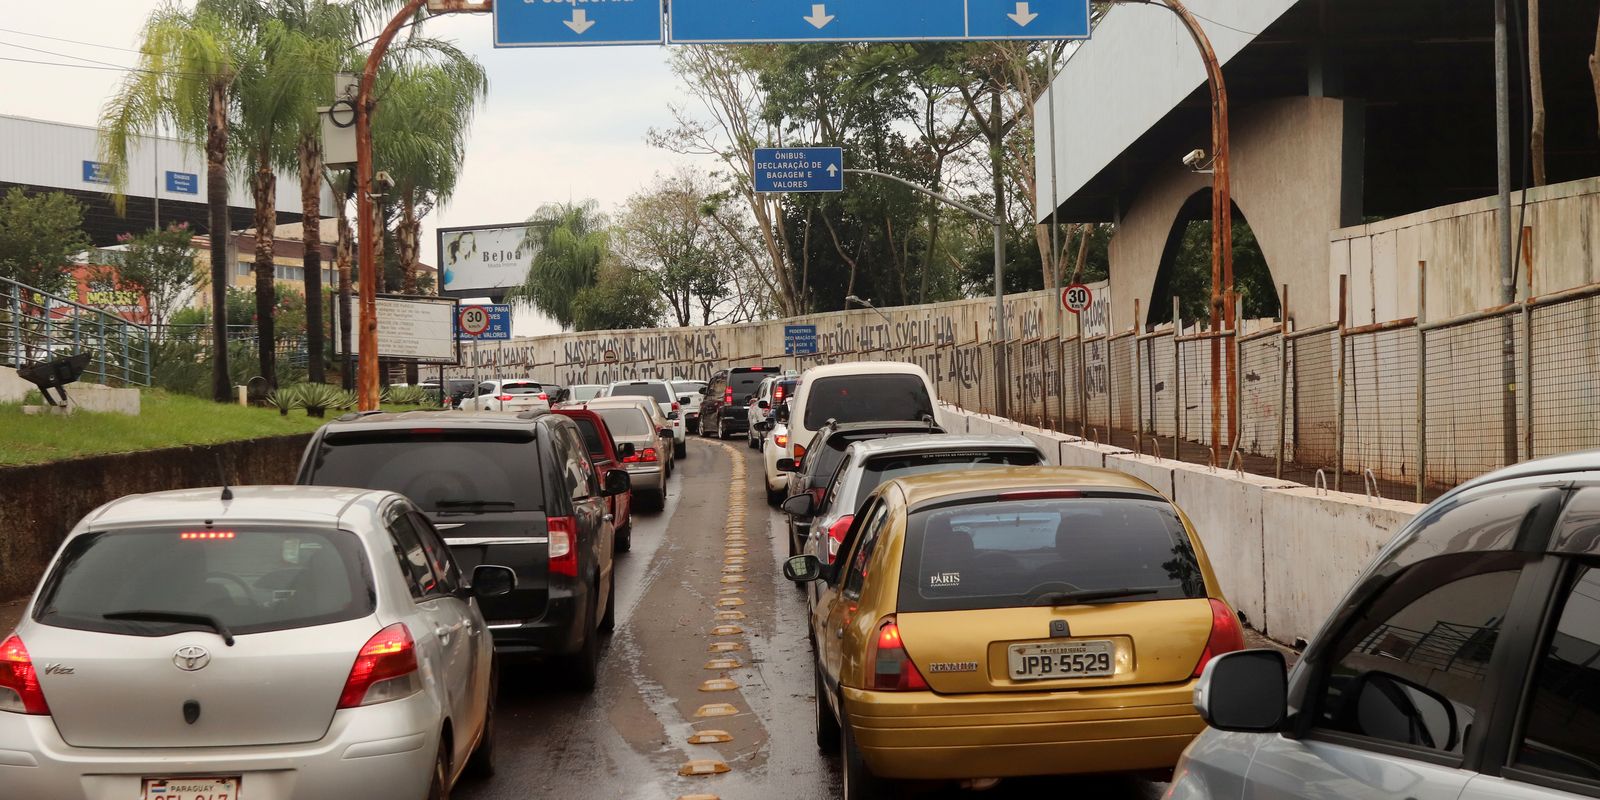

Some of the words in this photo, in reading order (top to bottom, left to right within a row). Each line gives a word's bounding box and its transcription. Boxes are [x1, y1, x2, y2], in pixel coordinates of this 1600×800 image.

[775, 151, 806, 160] ÔNIBUS:
[757, 161, 809, 170] DECLARAÇÃO
[766, 171, 805, 179] BAGAGEM
[1068, 289, 1086, 303] 30
[467, 311, 482, 323] 30
[930, 572, 960, 584] PARIS
[929, 661, 978, 672] RENAULT
[170, 785, 215, 793] PARAGUAY
